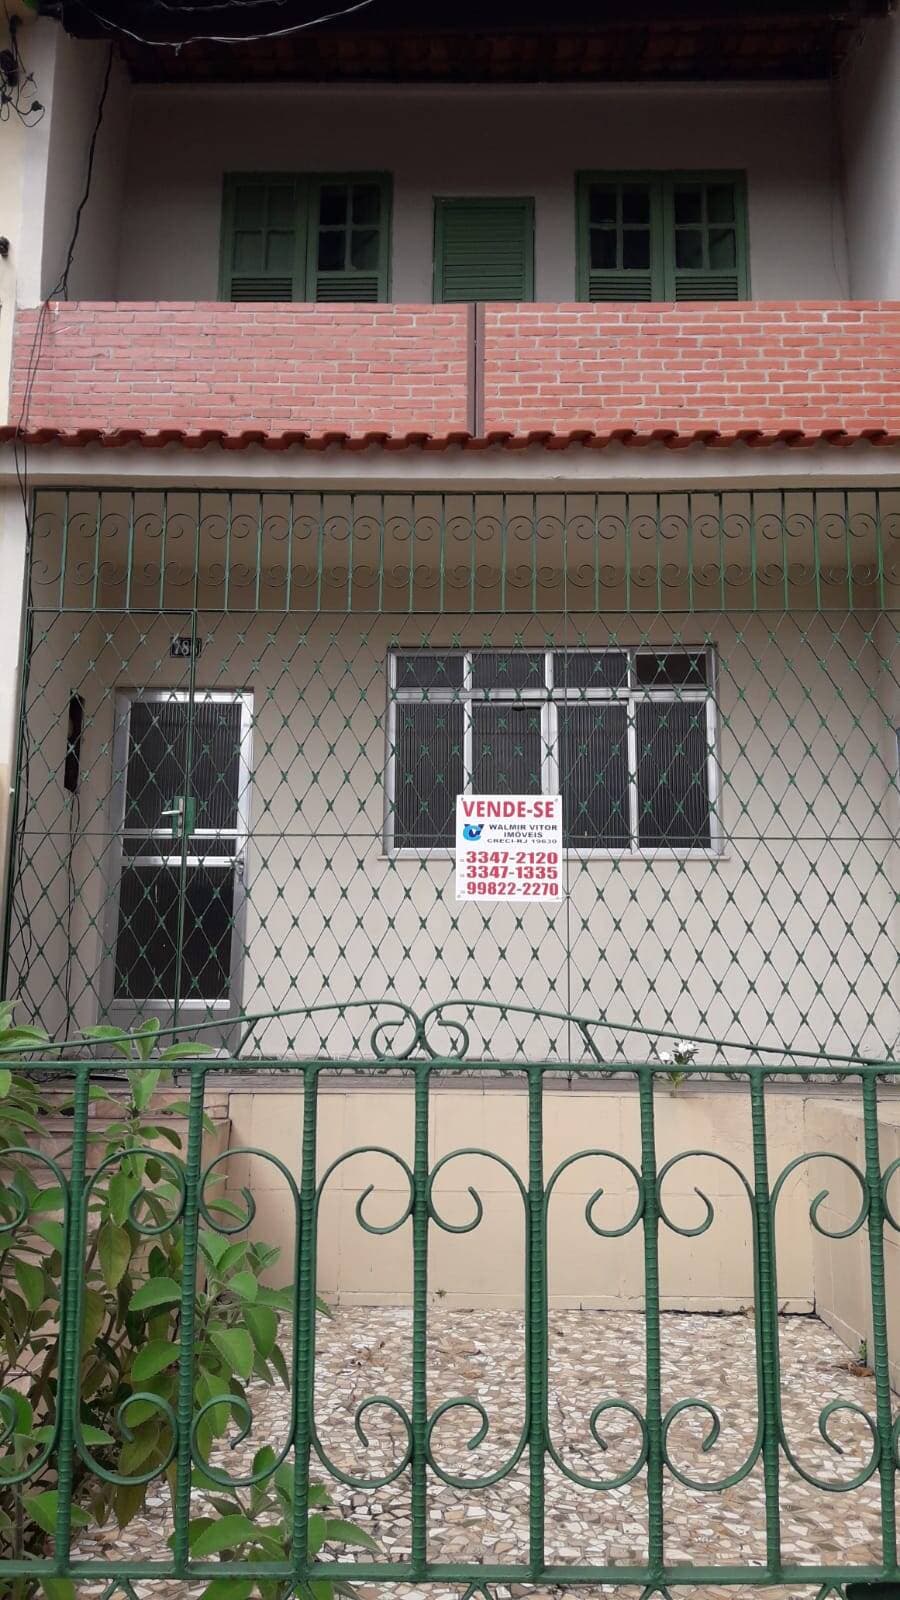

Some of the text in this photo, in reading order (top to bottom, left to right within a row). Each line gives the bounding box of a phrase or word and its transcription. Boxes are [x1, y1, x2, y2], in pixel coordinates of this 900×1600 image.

[463, 801, 554, 818] VENDE-SE
[466, 851, 558, 864] 3347-2120
[466, 865, 558, 879] 3347-1335
[467, 881, 559, 896] 99822-2270
